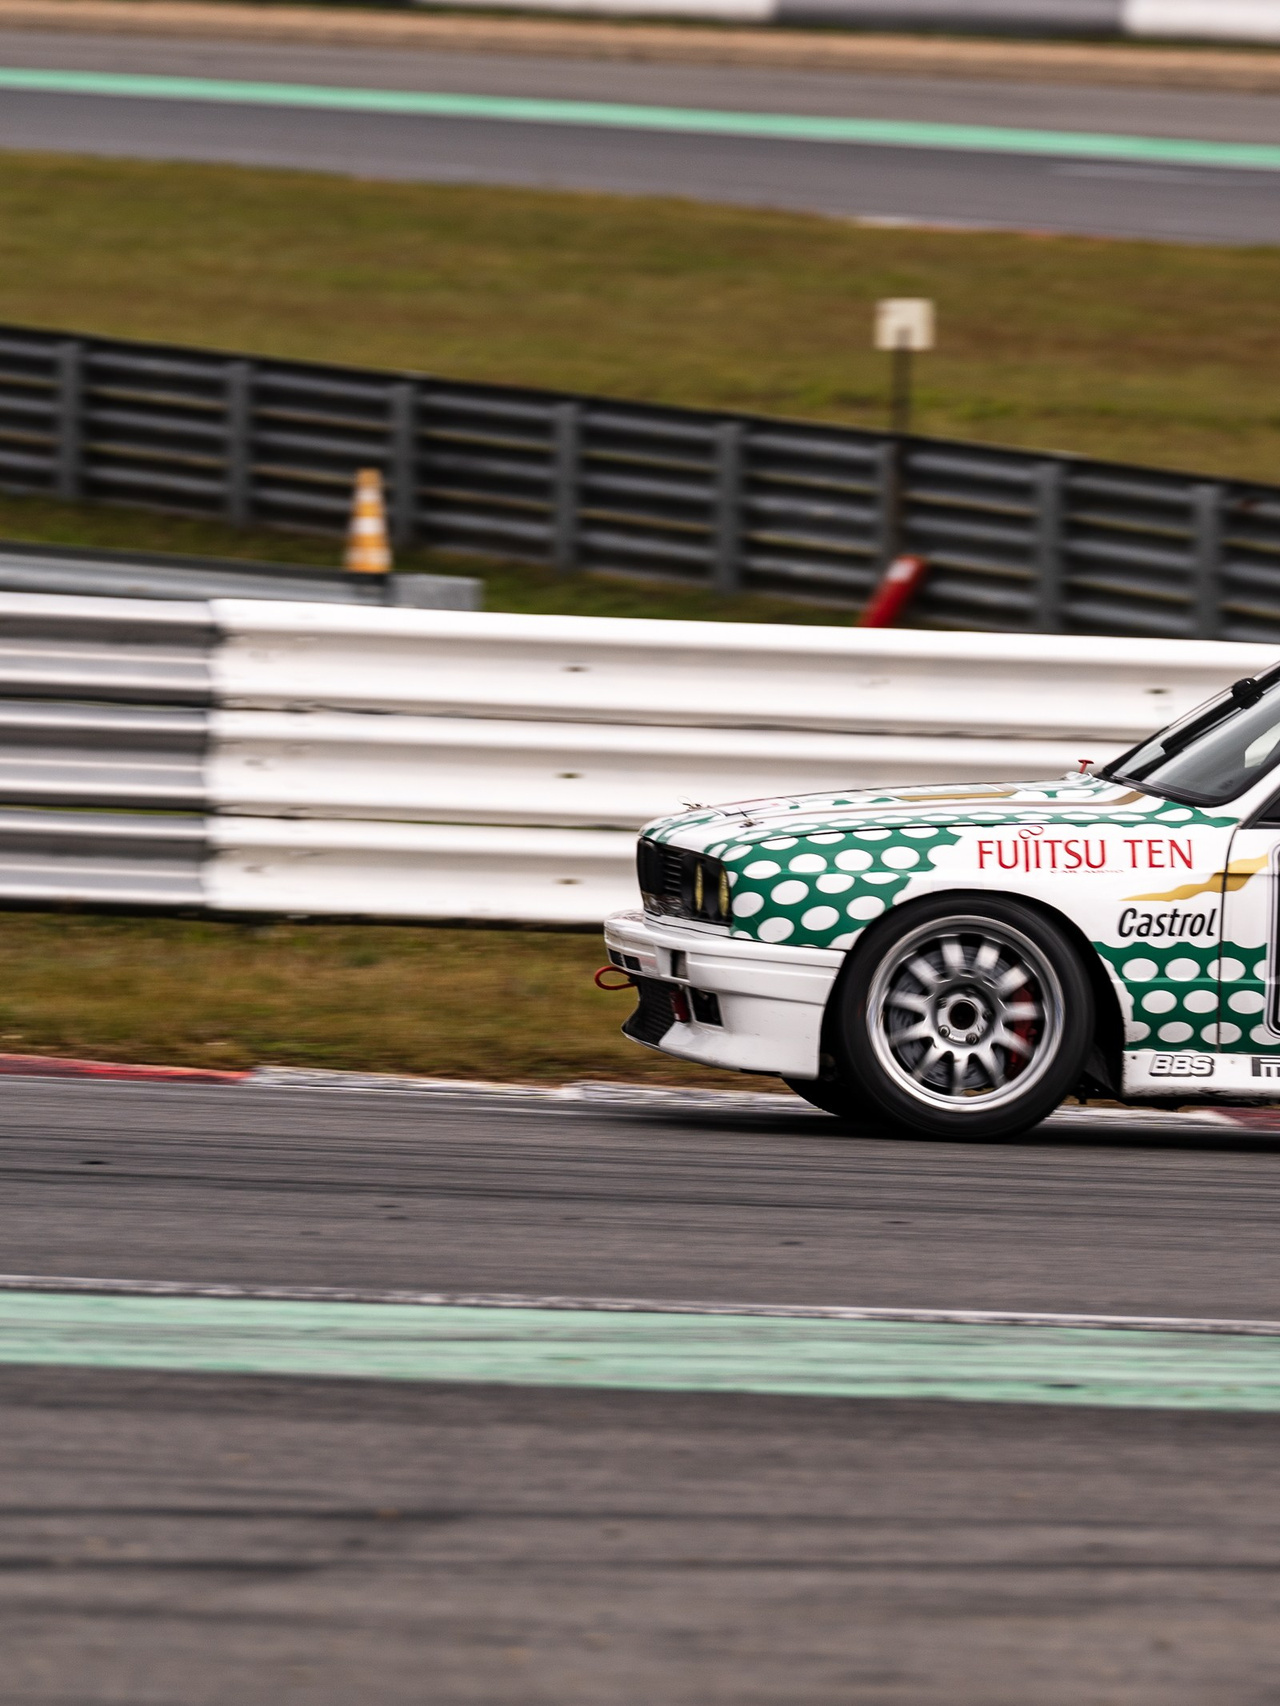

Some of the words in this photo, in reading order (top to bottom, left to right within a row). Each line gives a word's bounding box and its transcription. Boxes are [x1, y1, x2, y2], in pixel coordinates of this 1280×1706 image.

[977, 825, 1107, 873] FUJITSU
[1123, 839, 1193, 870] TEN
[1118, 907, 1217, 938] Castrol
[1149, 1054, 1214, 1077] BBS
